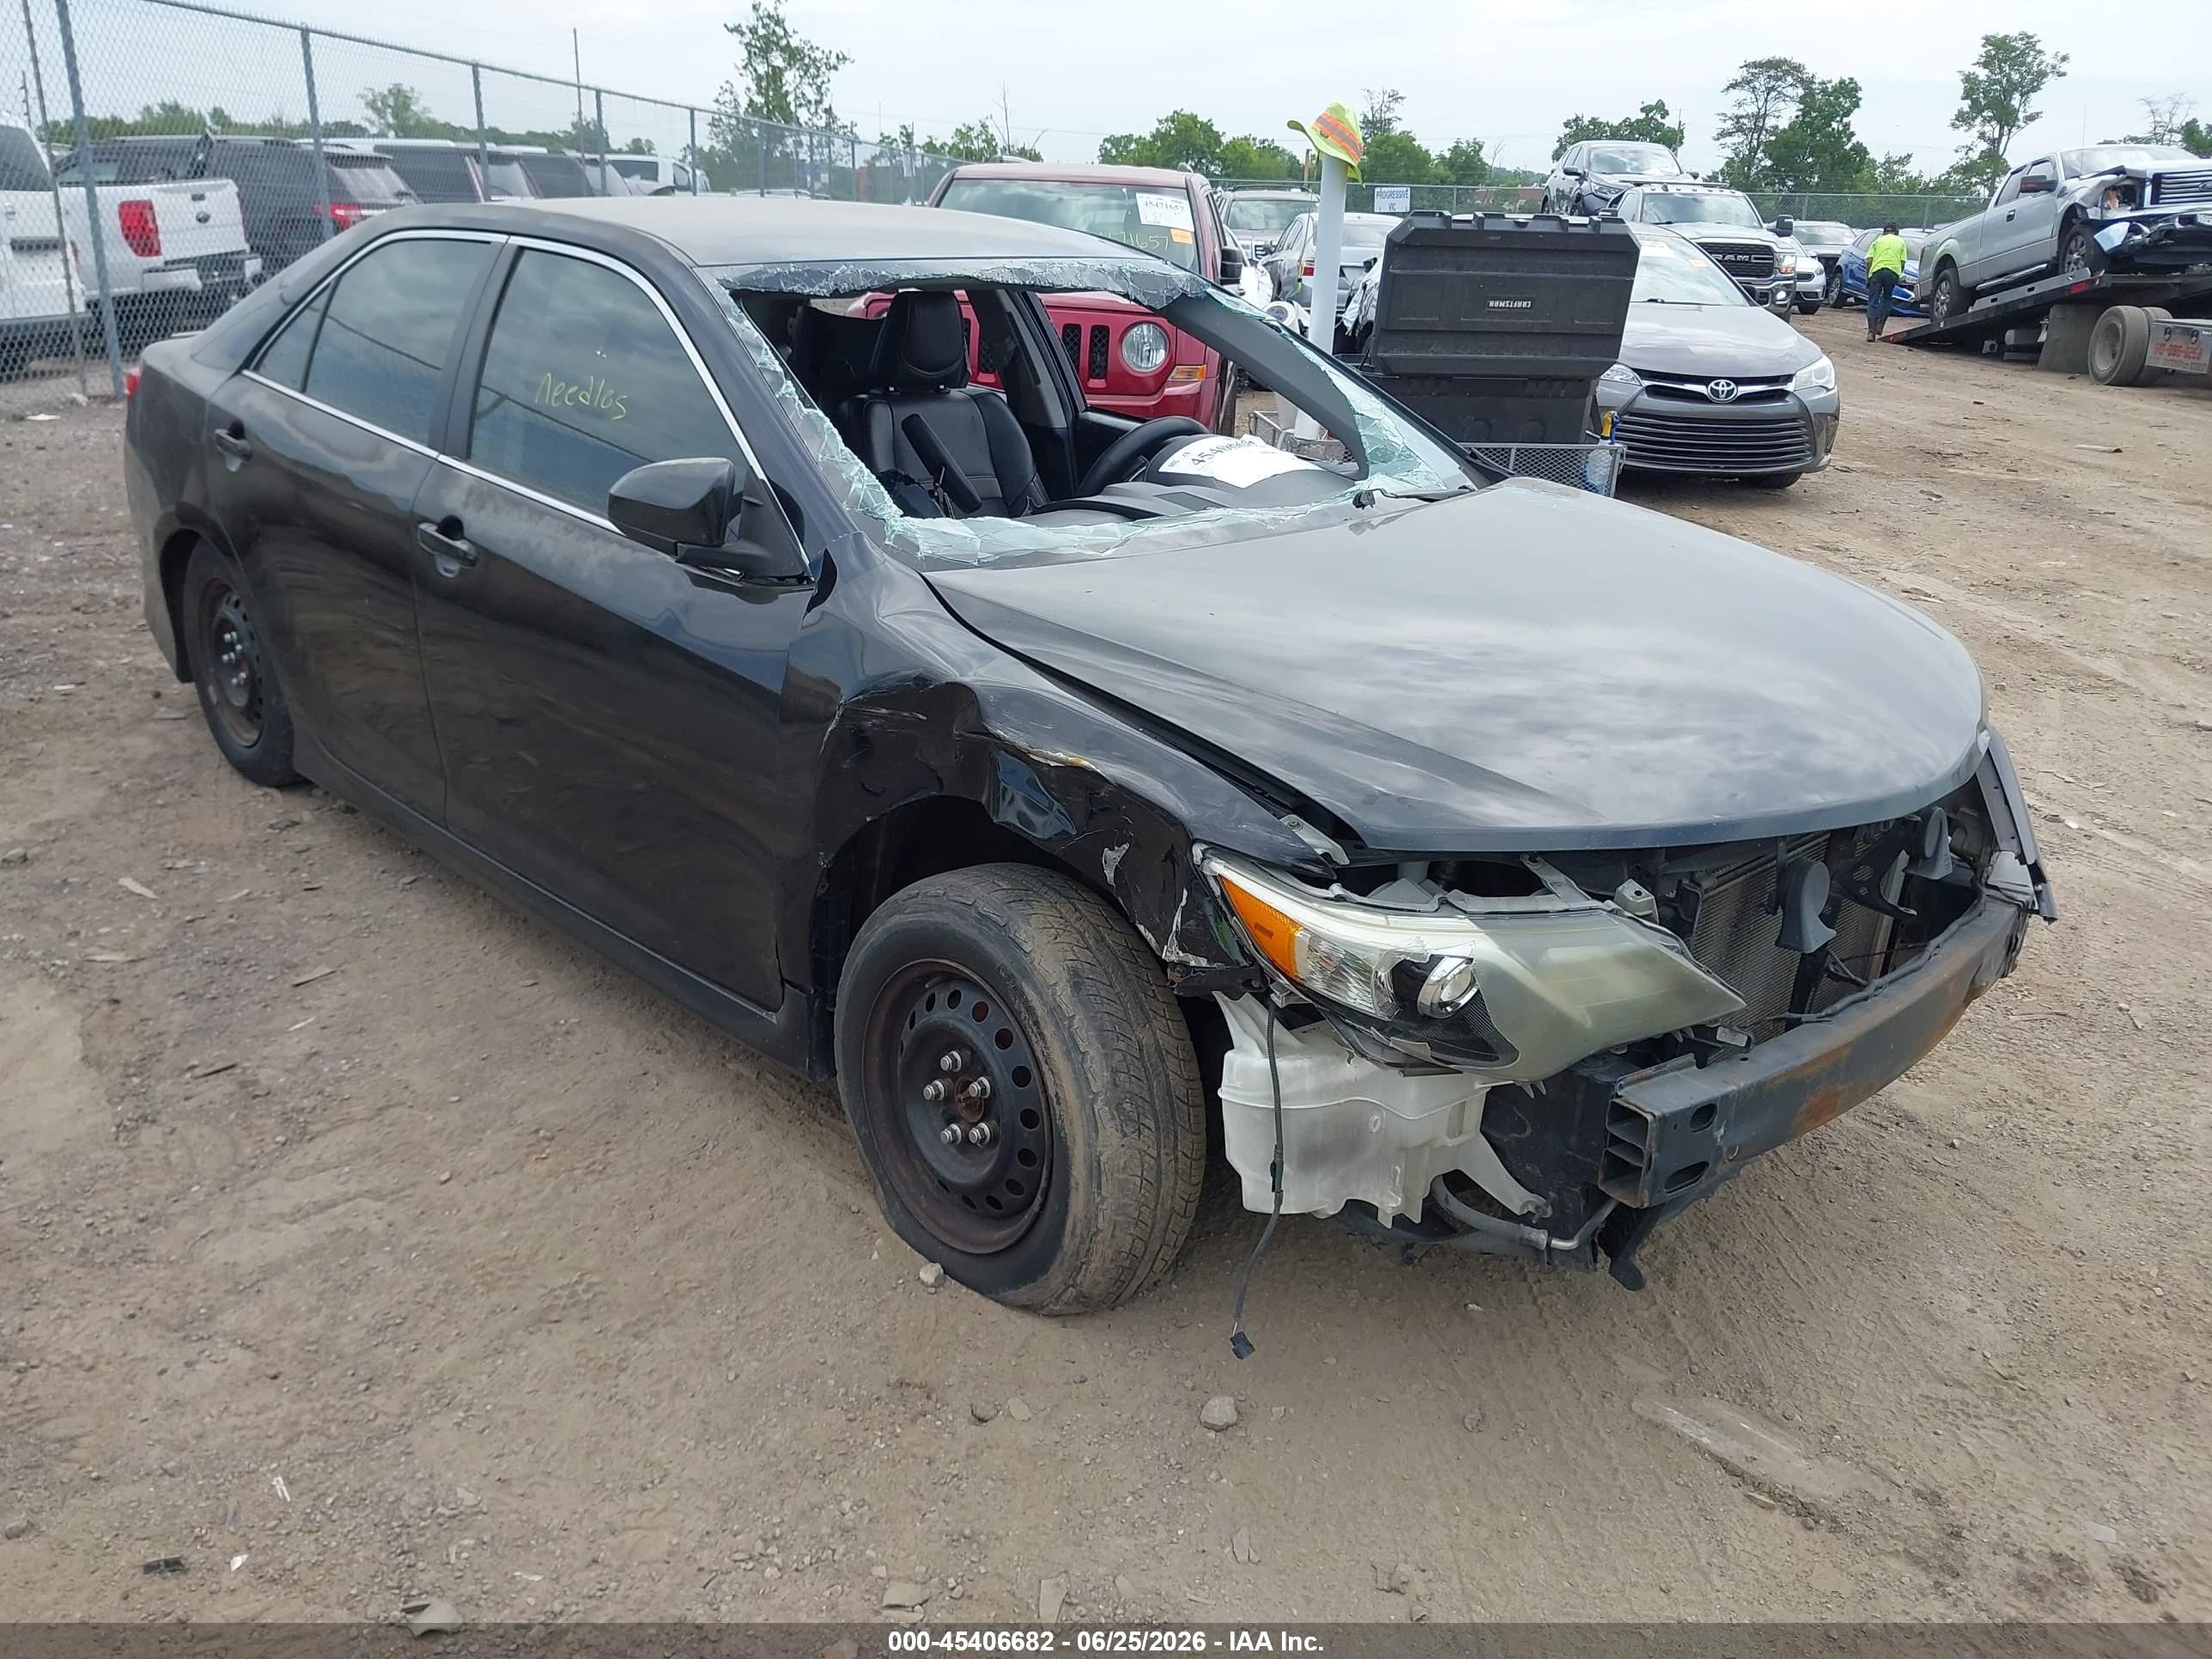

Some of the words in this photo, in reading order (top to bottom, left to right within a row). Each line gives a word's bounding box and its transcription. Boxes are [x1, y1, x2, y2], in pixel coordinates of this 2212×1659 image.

[1376, 190, 1409, 199] PROGRESSIVE
[1099, 231, 1169, 252] 71657
[1488, 300, 1532, 308] CRAFTSMAN
